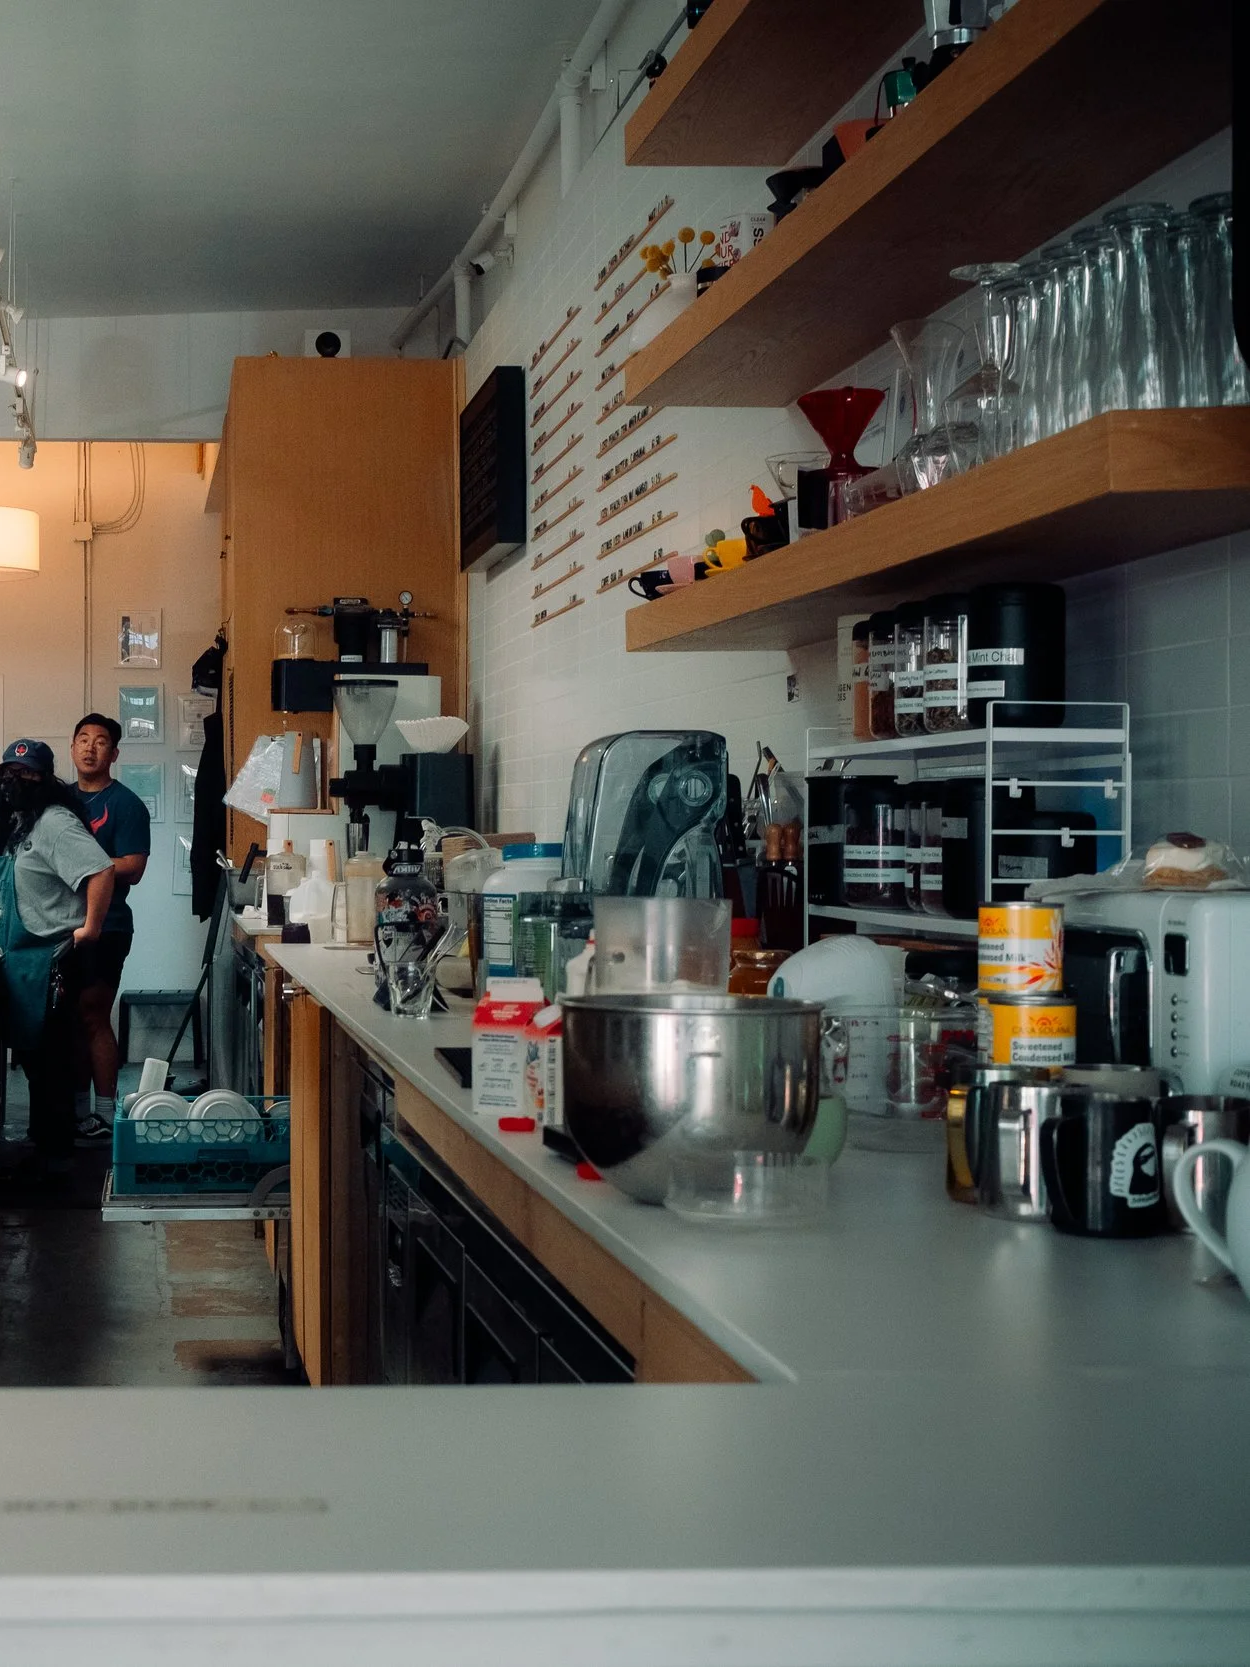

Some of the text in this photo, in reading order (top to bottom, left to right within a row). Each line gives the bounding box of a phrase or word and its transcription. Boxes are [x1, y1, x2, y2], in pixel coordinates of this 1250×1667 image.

[972, 651, 989, 663] Mint
[1012, 1041, 1063, 1051] Sweetened
[1012, 1051, 1062, 1062] Condensed
